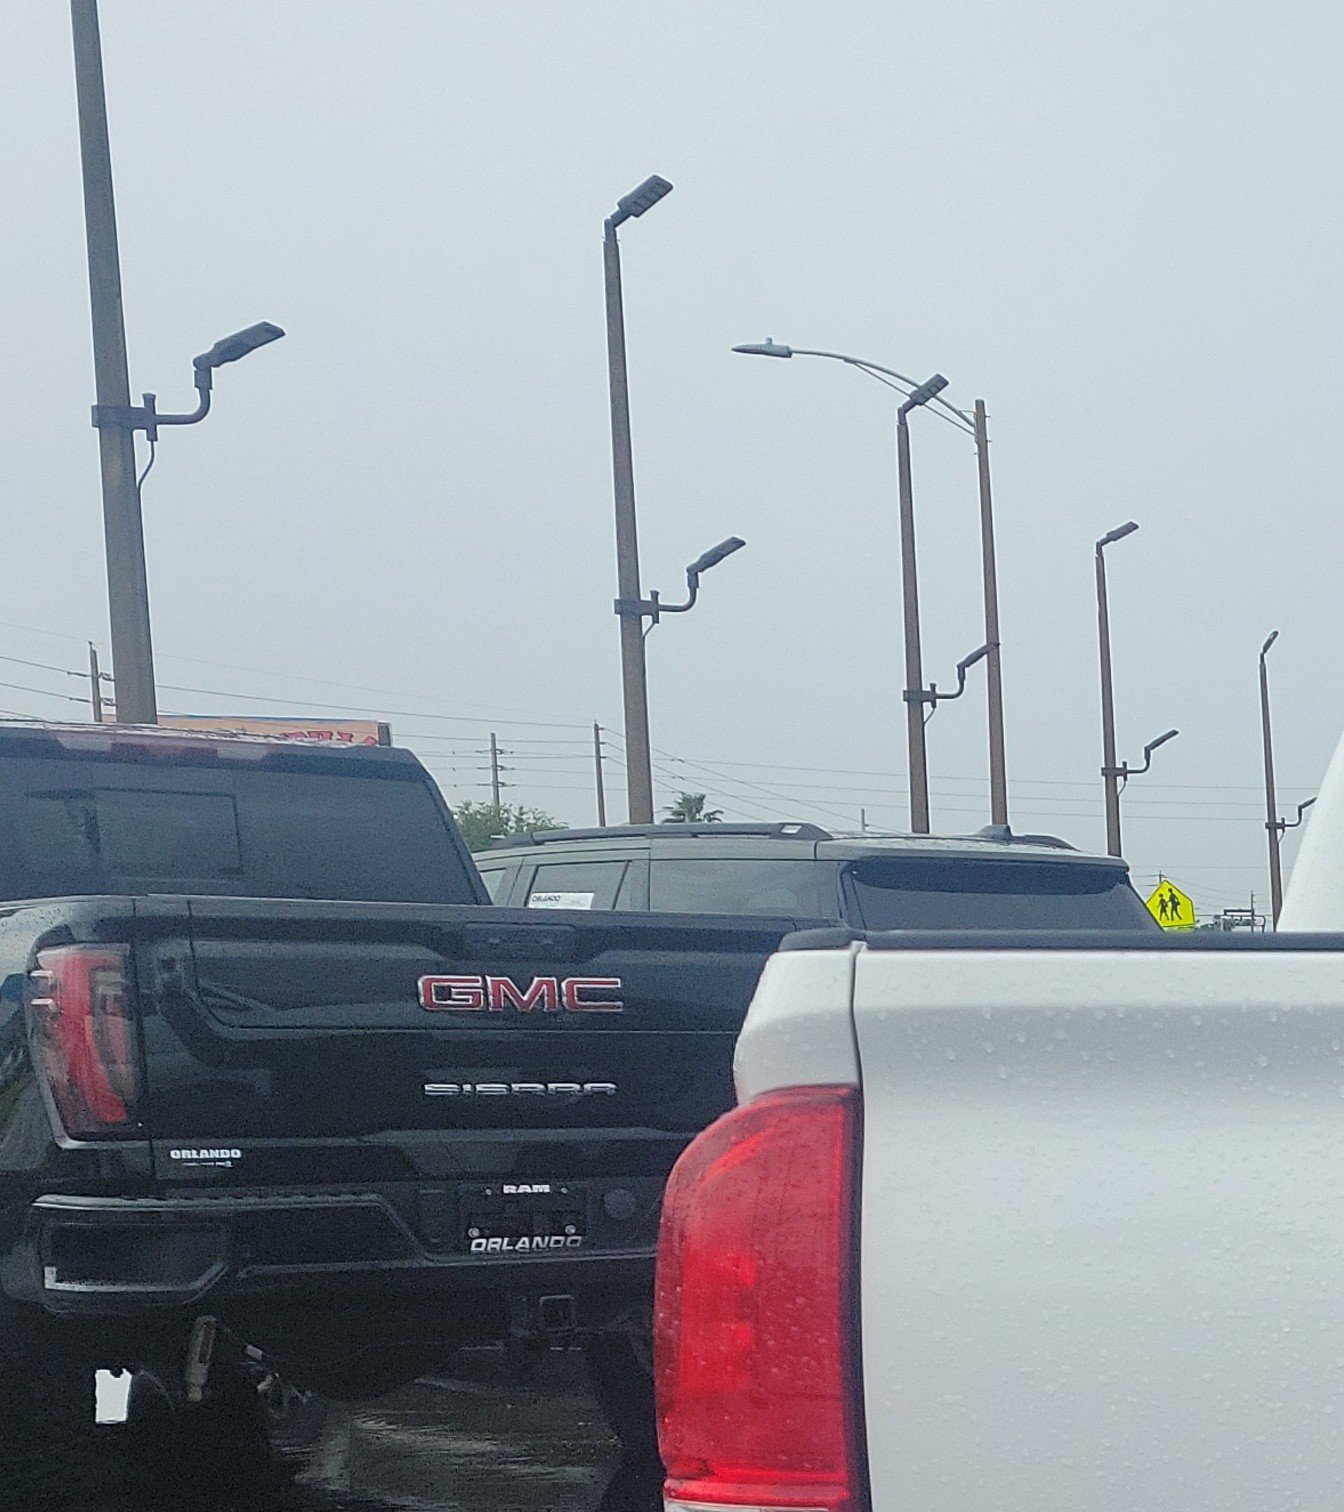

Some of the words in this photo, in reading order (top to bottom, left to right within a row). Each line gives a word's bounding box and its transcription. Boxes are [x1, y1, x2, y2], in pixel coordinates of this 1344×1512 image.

[417, 974, 624, 1012] GMC
[424, 1083, 618, 1095] SIERRA
[170, 1148, 242, 1159] ORLANDO
[503, 1184, 550, 1194] RAM
[470, 1235, 582, 1251] ORLANDO
